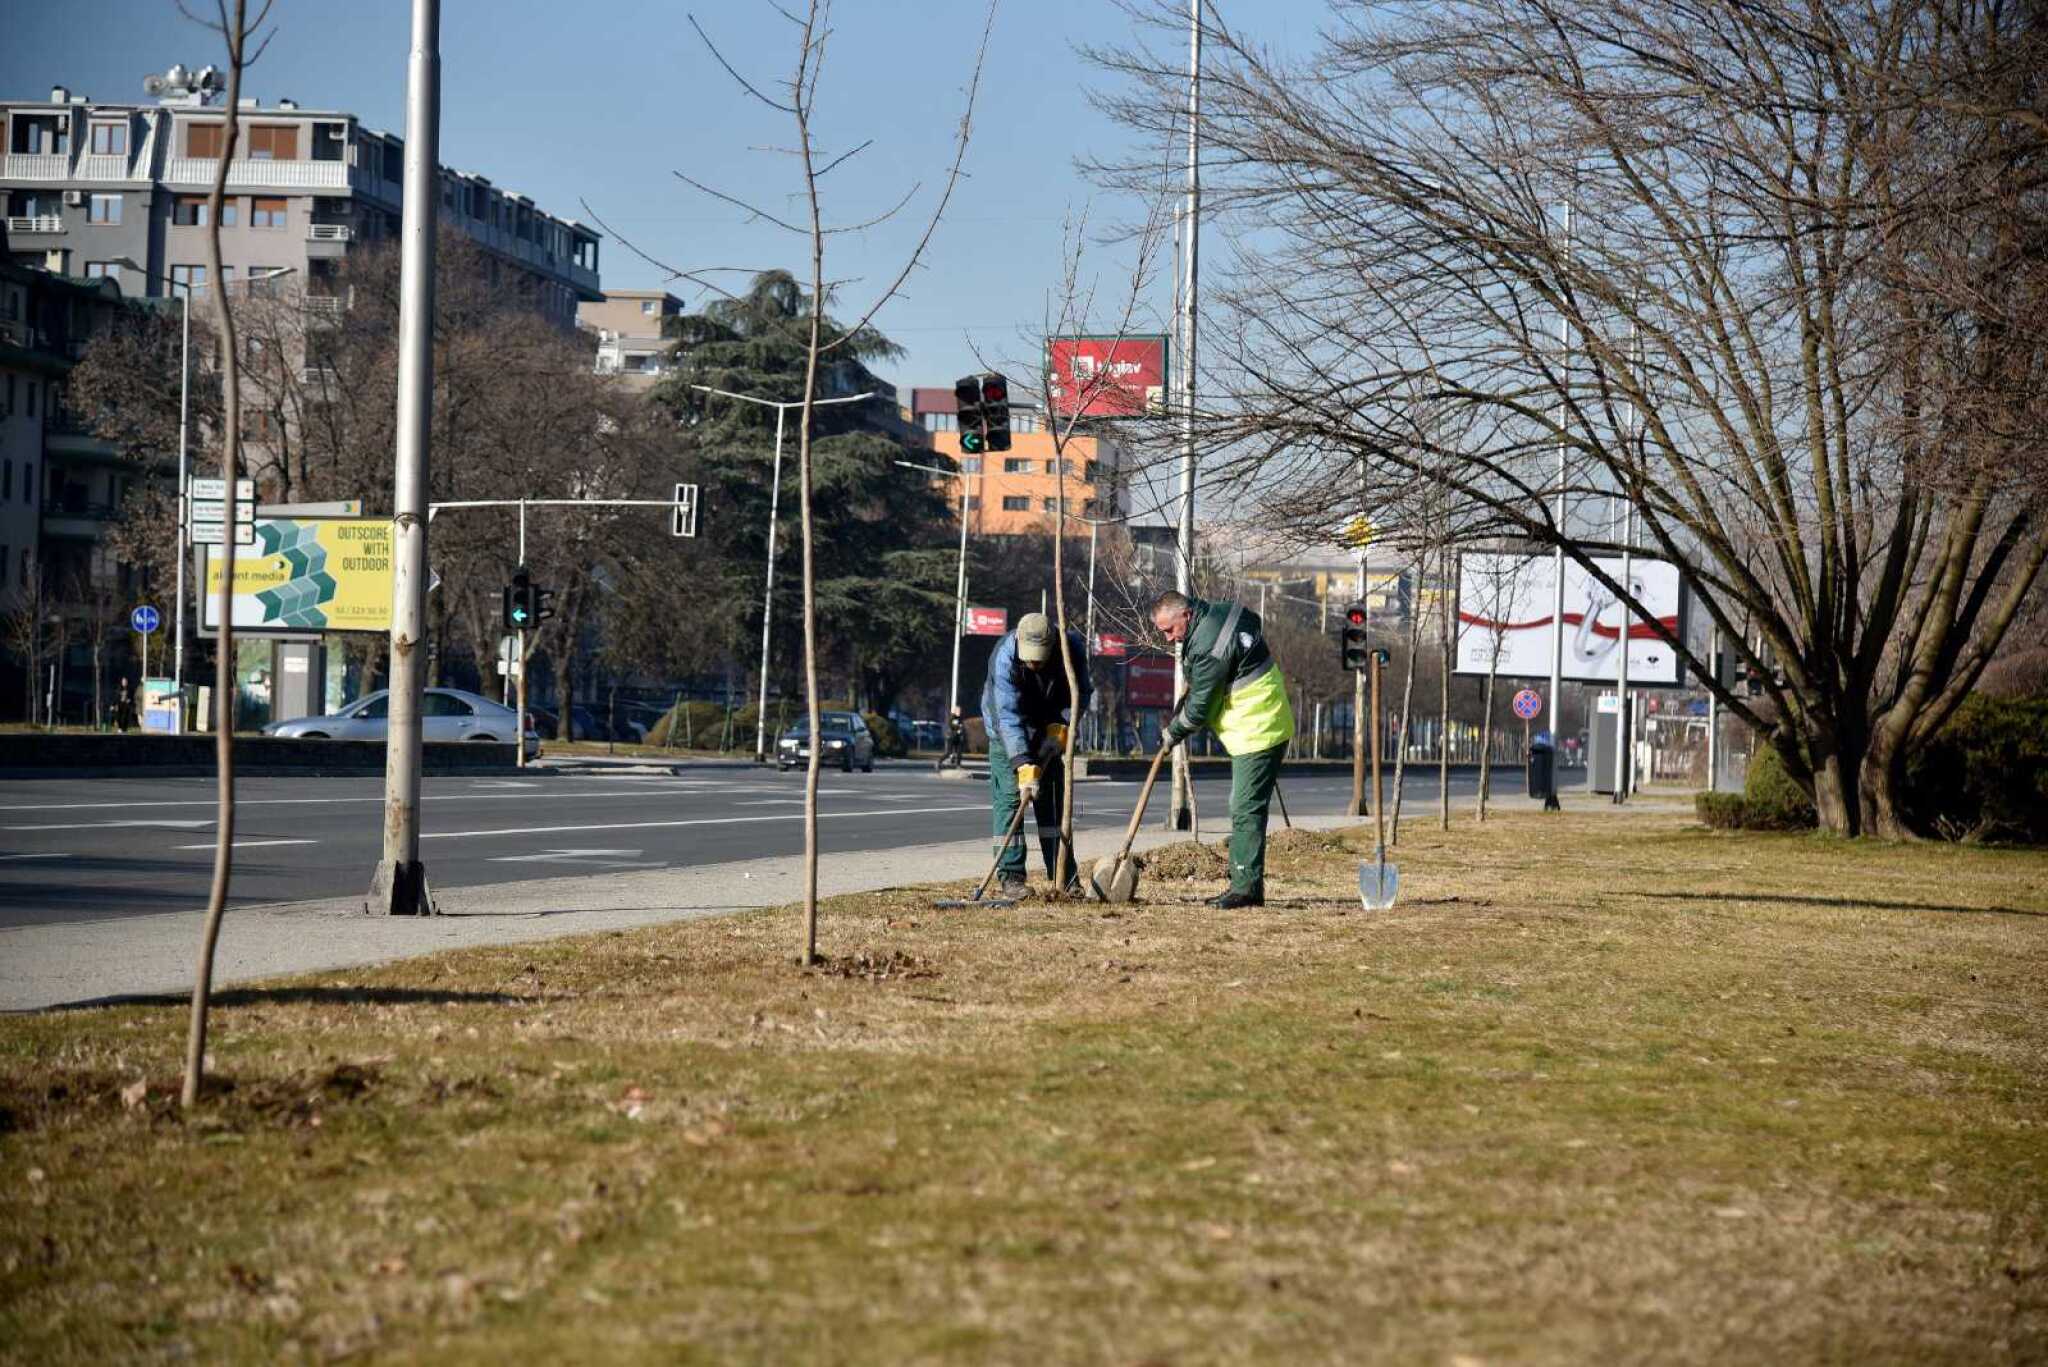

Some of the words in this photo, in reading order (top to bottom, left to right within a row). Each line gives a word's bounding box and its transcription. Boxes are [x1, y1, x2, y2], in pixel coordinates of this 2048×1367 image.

[338, 527, 388, 540] OUTSCORE
[364, 542, 389, 555] WITH
[342, 559, 389, 571] OUTDOOR
[213, 569, 248, 581] aent
[250, 571, 285, 581] media
